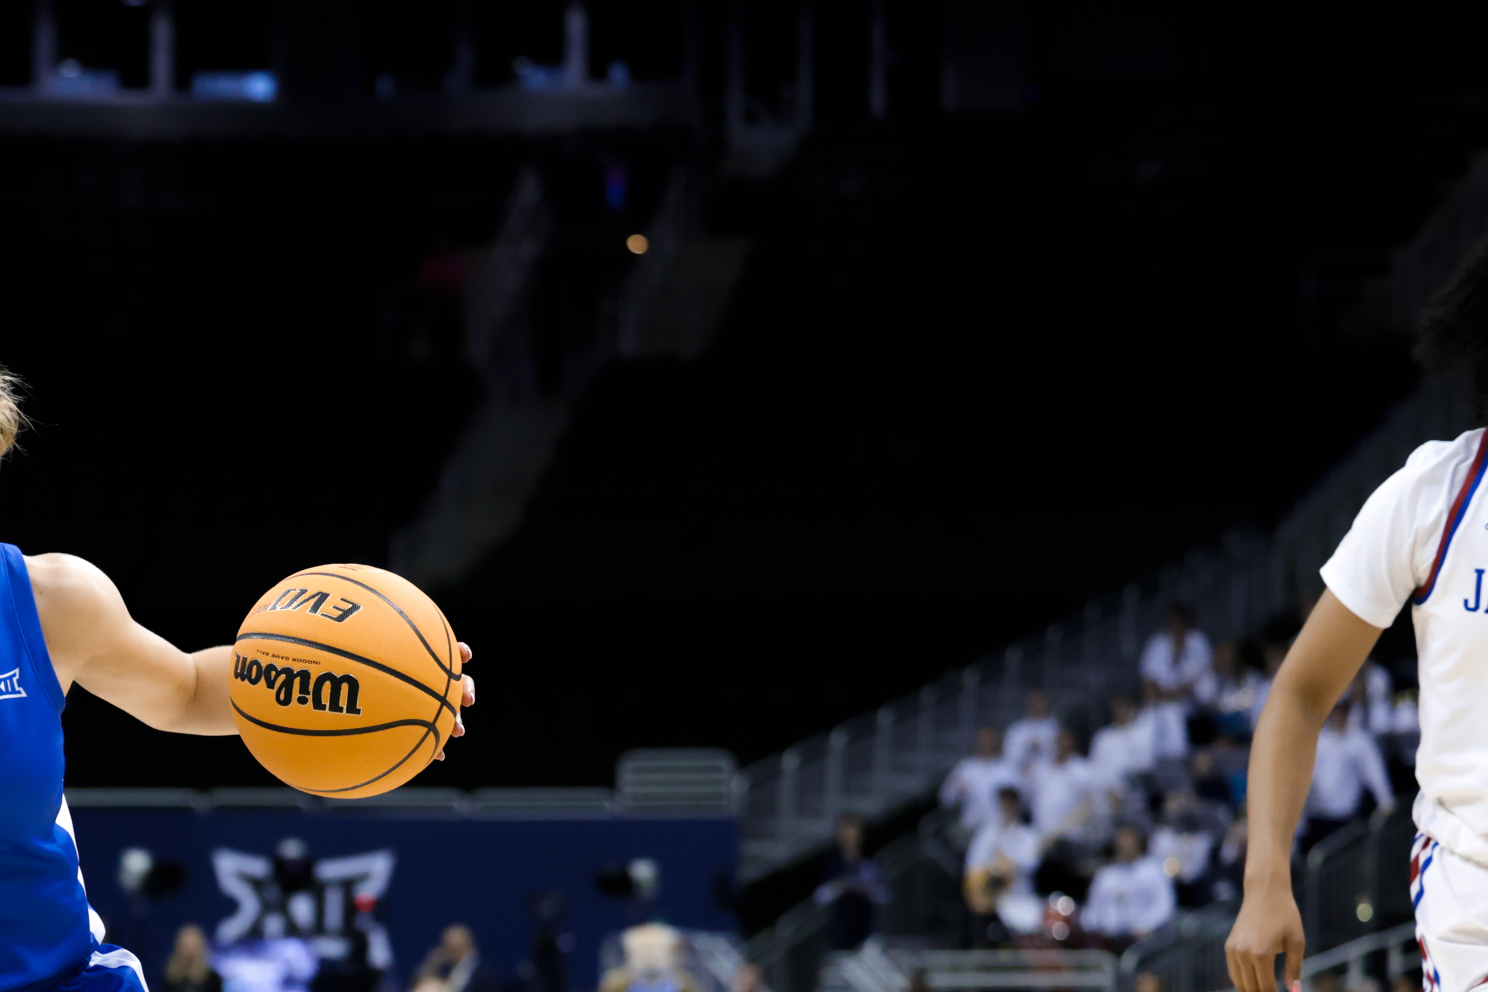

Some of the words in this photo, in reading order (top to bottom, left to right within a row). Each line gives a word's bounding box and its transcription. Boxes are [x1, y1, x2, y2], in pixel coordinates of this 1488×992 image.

[269, 588, 363, 623] EVO
[271, 653, 290, 661] GAME
[292, 657, 321, 665] INDOOR
[233, 651, 362, 716] Wilson
